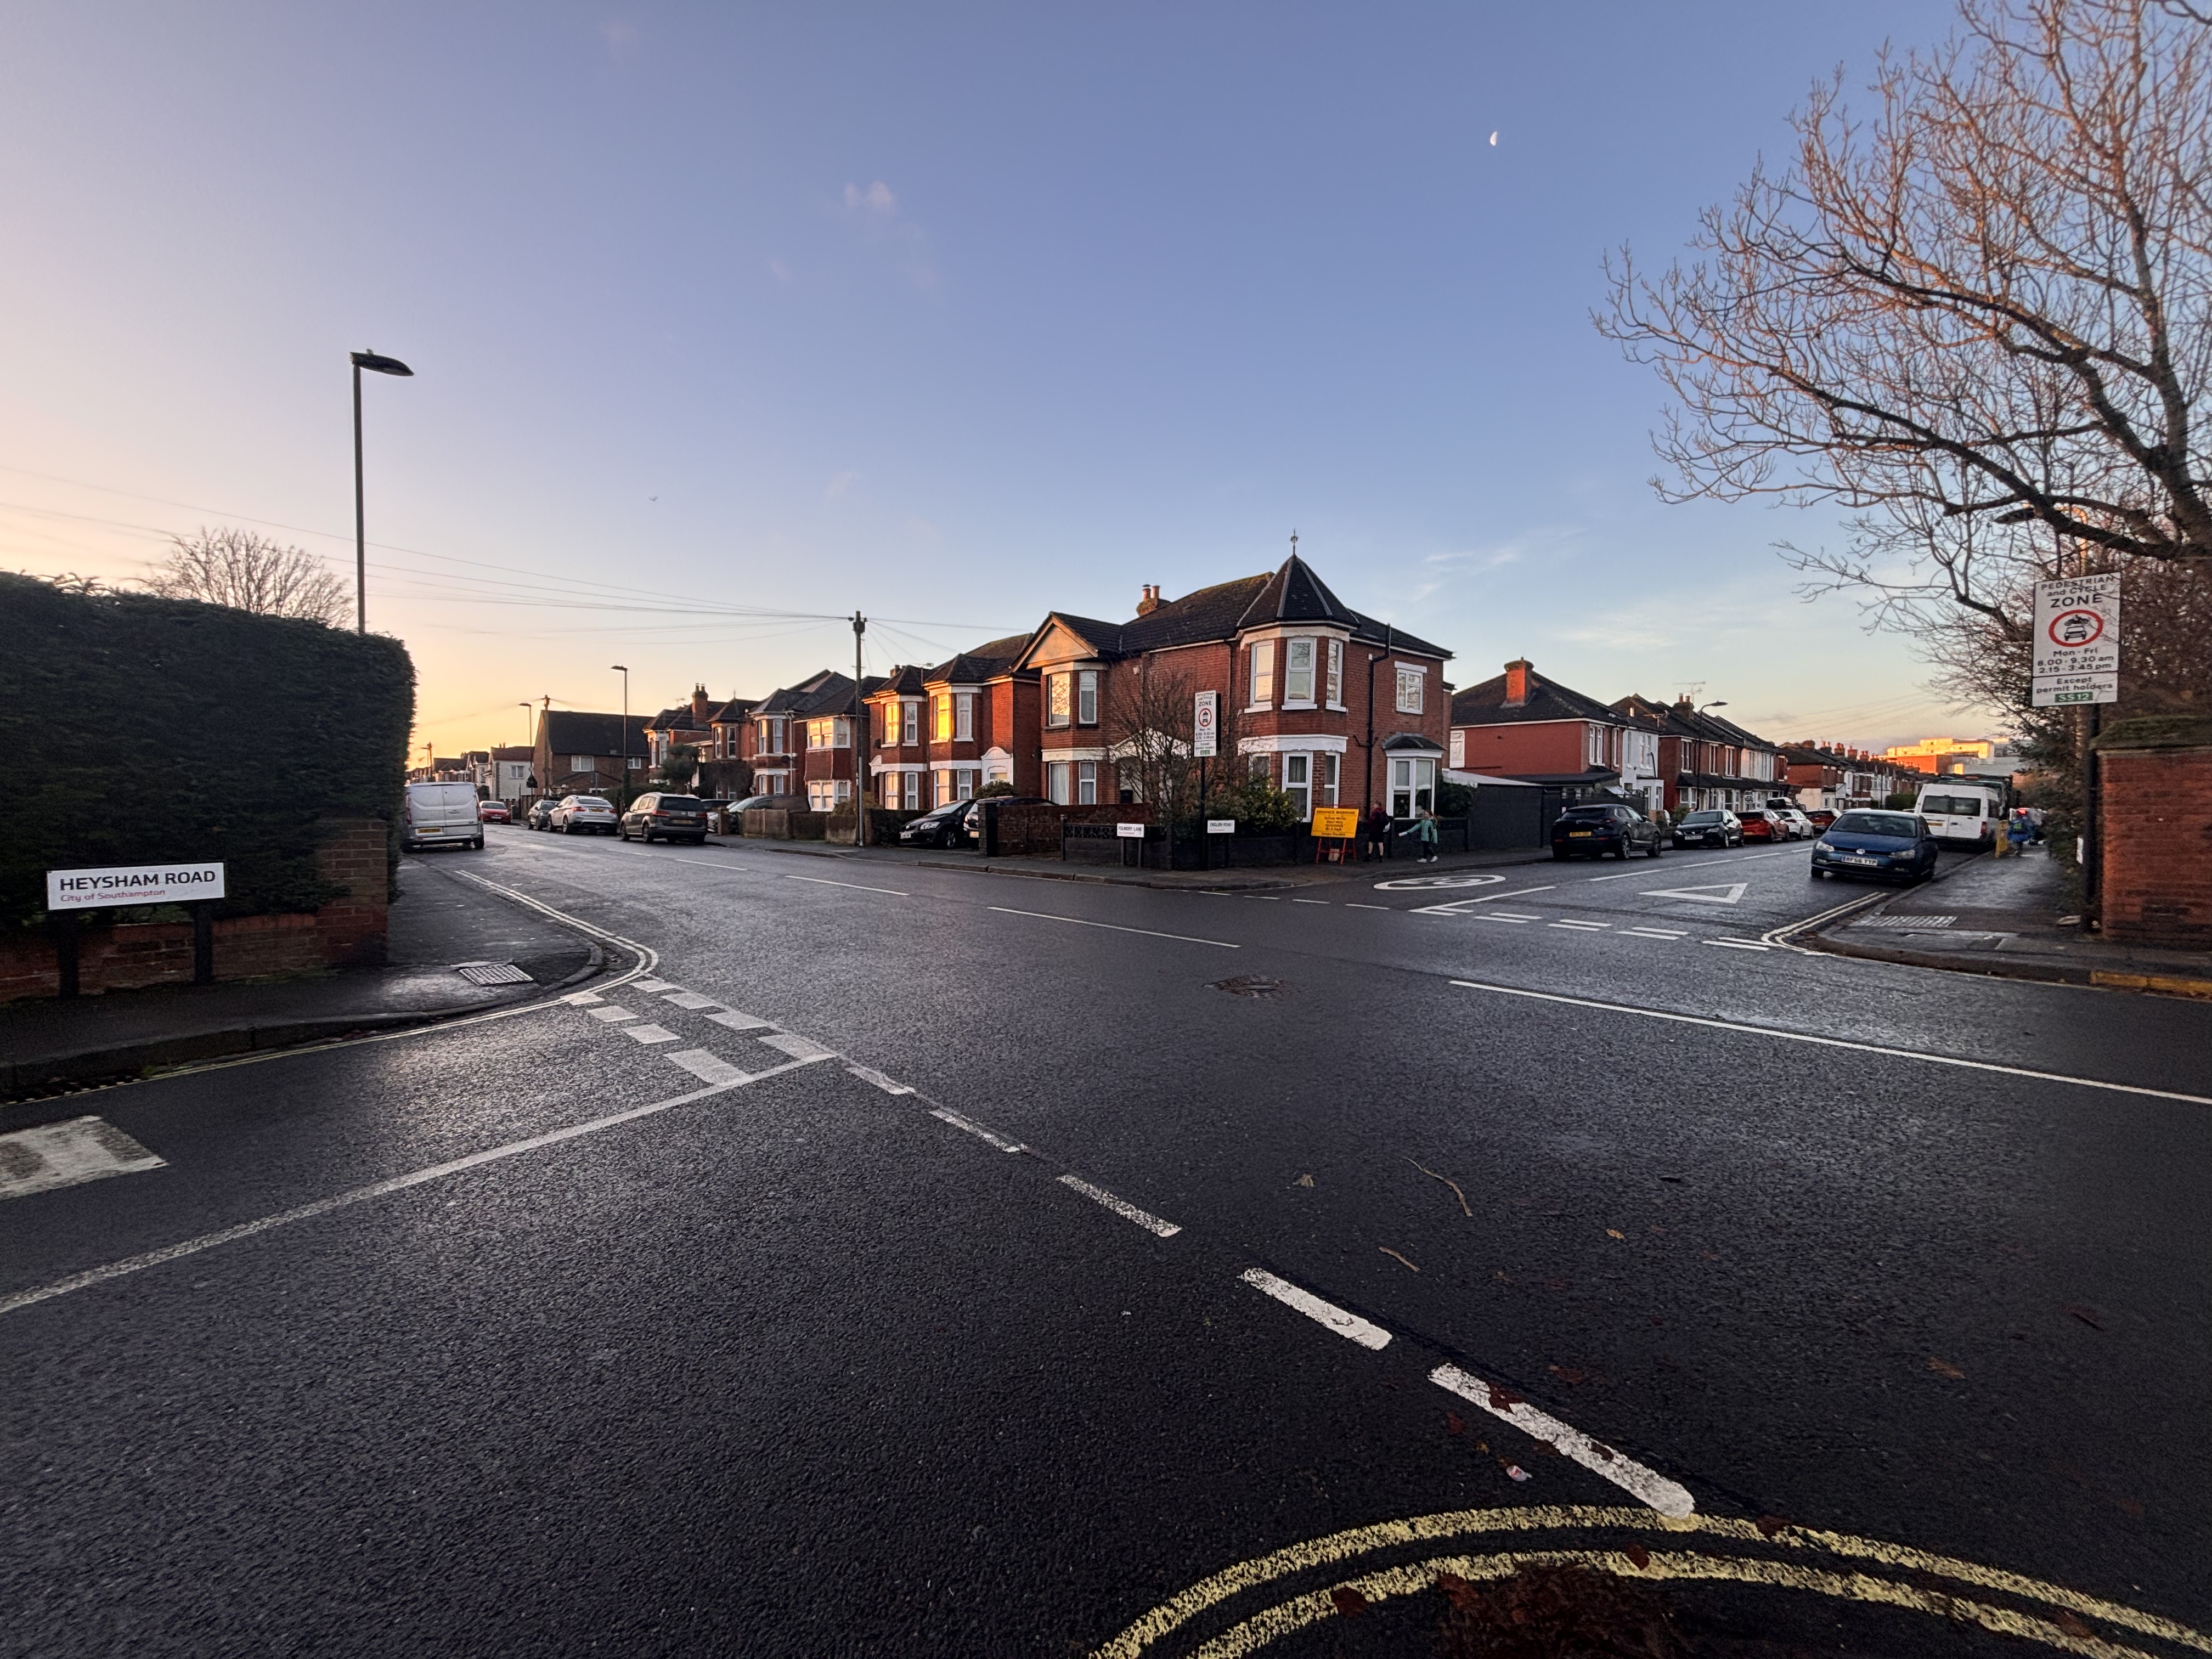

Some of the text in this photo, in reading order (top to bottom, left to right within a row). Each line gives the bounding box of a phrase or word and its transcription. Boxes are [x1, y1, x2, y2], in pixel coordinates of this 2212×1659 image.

[2041, 576, 2114, 590] PEDESTRIAN
[2070, 584, 2107, 594] CYCLE
[2050, 594, 2103, 608] ZONE
[2037, 658, 2062, 667] 8.00
[2070, 656, 2096, 664] 9.30
[2068, 663, 2093, 672] 3.45
[2056, 676, 2092, 685] Except
[59, 870, 216, 891] HEYSHAM ROAD
[60, 890, 166, 902] City of Southampton
